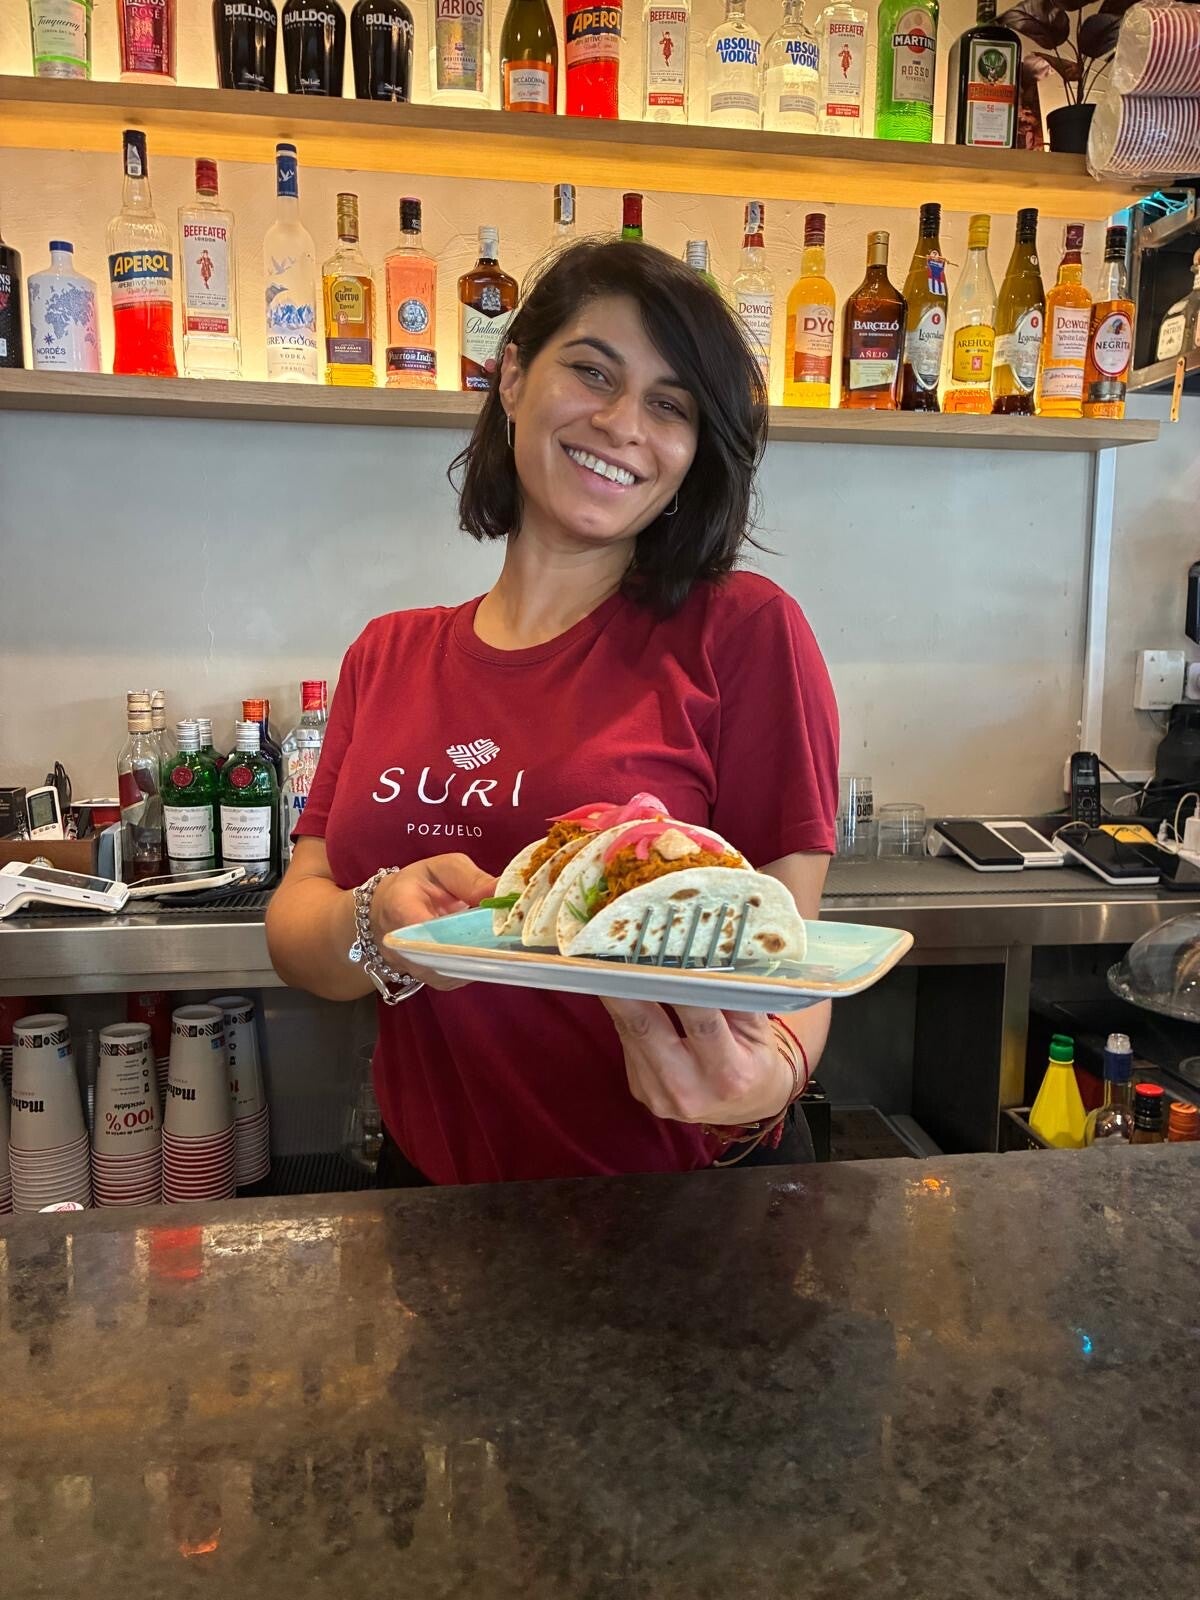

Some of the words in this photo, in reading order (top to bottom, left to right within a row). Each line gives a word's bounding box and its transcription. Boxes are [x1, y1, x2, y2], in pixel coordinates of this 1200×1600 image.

[131, 6, 161, 19] ROSÉ
[224, 4, 276, 26] BULLDOG
[285, 10, 336, 26] BULLDOG
[650, 10, 686, 23] BEEFEATER
[38, 15, 80, 32] Tanqueray
[572, 10, 620, 34] APEROL
[829, 23, 864, 37] BEEFEATER
[716, 37, 761, 54] ABSOLUT
[720, 50, 758, 66] VODKA
[901, 65, 929, 78] ROSSO
[184, 225, 227, 242] BEEFEATER
[114, 254, 169, 277] APEROL
[335, 290, 359, 302] Cuervo
[854, 320, 899, 332] BARCELÓ
[36, 346, 66, 355] NORDÉS
[860, 350, 888, 358] AÑEJO
[372, 766, 525, 807] SURI
[168, 822, 207, 833] Tanqueray
[225, 822, 265, 834] Tanqueray
[407, 823, 483, 837] POZUELO
[114, 1100, 145, 1110] reciclable
[123, 1106, 154, 1127] 100
